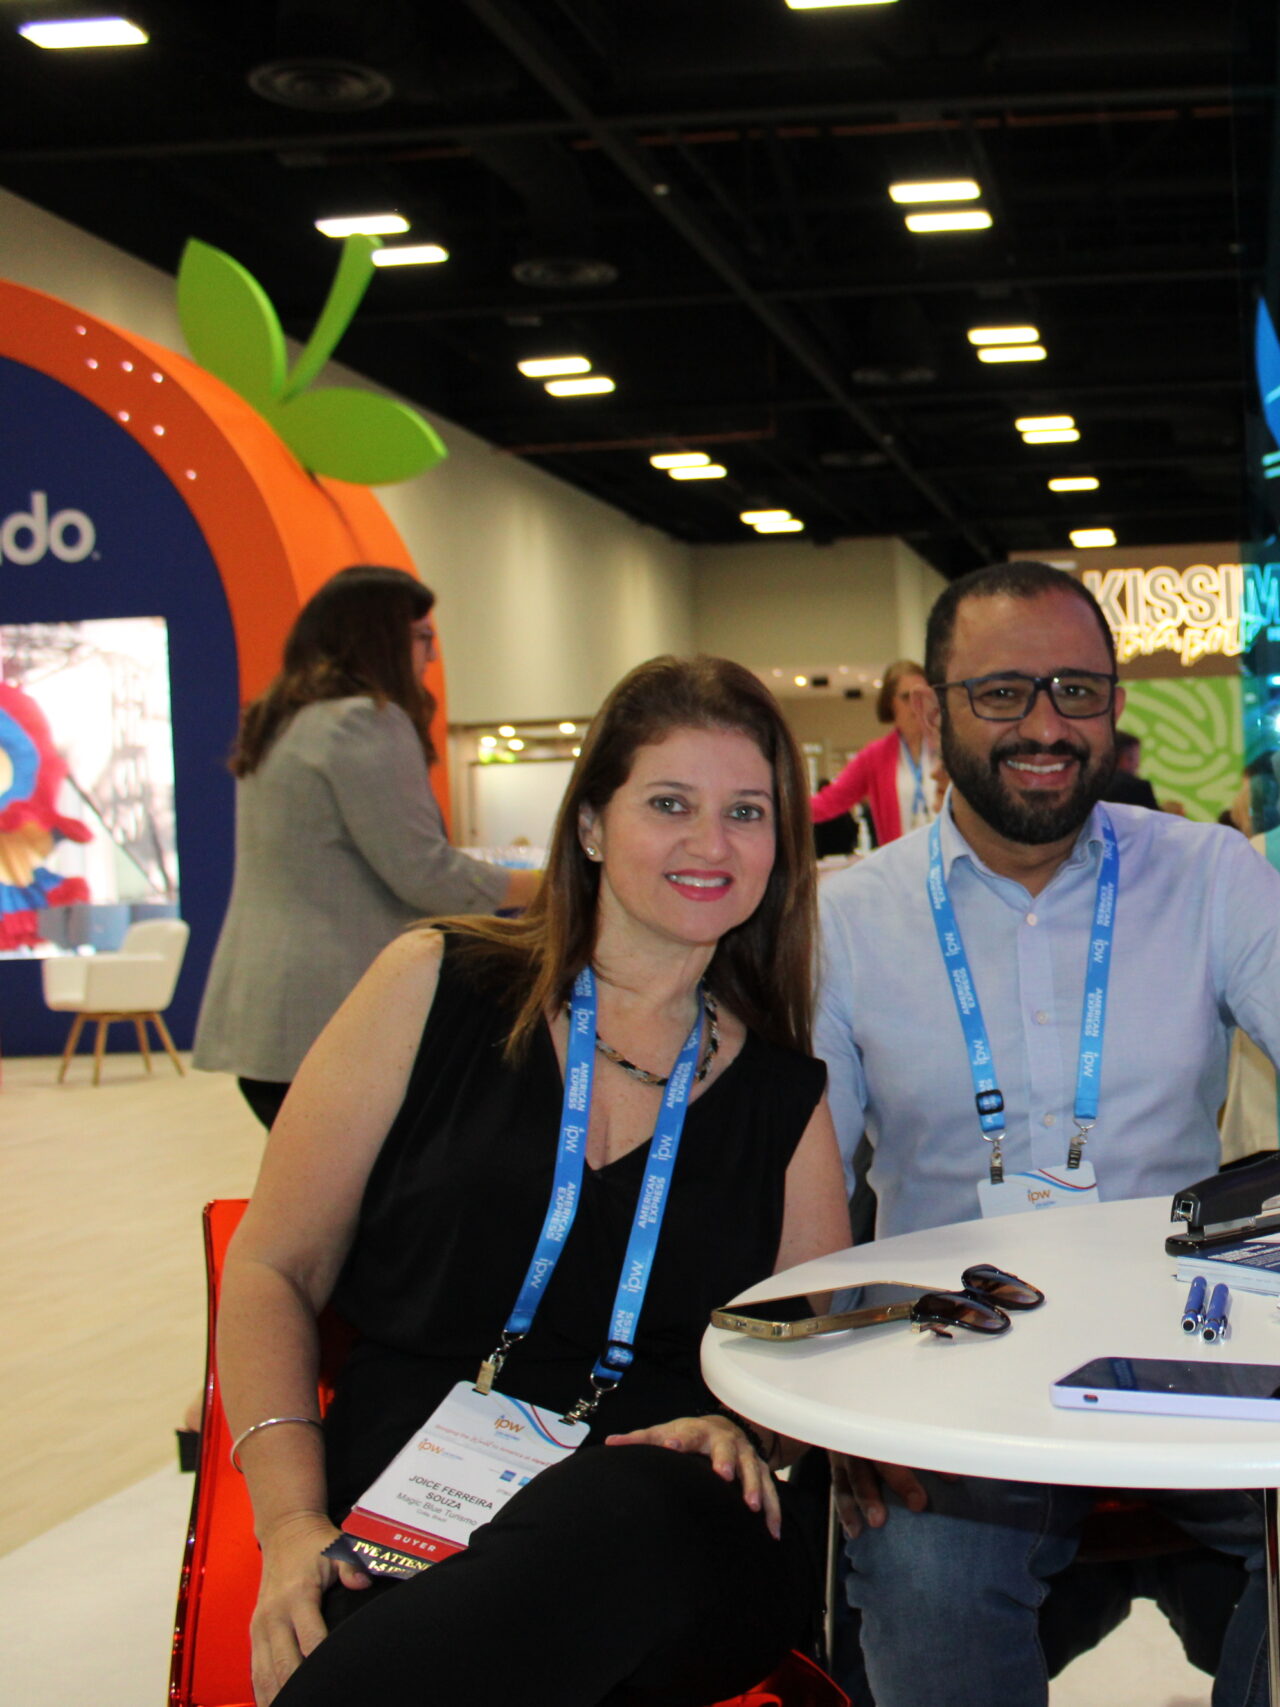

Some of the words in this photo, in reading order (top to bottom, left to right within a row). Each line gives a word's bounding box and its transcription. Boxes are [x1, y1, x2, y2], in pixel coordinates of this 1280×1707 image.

[944, 932, 961, 957] ipw
[1092, 938, 1109, 964] ipw
[953, 969, 971, 1015] AMERICAN
[577, 1008, 595, 1034] ipw
[1092, 987, 1104, 1037] AMERICAN
[973, 1039, 990, 1065] ipw
[1081, 1051, 1100, 1078] ipw
[568, 1067, 581, 1110] EXPRESS
[577, 1062, 590, 1112] AMERICAN
[666, 1062, 684, 1109] AMERICAN
[564, 1125, 585, 1154] ipw
[651, 1134, 674, 1161] ipw
[637, 1175, 657, 1229] AMERICAN
[648, 1176, 666, 1225] EXPRESS
[1027, 1188, 1052, 1205] ipw
[553, 1181, 577, 1242] AMERICAN
[530, 1258, 554, 1289] ipw
[621, 1260, 645, 1293] ipw
[494, 1415, 525, 1433] ipw
[418, 1438, 445, 1455] ipw
[408, 1475, 441, 1490] JOICE
[441, 1485, 494, 1510] FERREIRA
[425, 1492, 462, 1510] SOUZA
[423, 1502, 443, 1514] Blue
[445, 1509, 478, 1526] Turismo
[352, 1541, 382, 1558] I'VE
[393, 1533, 437, 1552] BUYER
